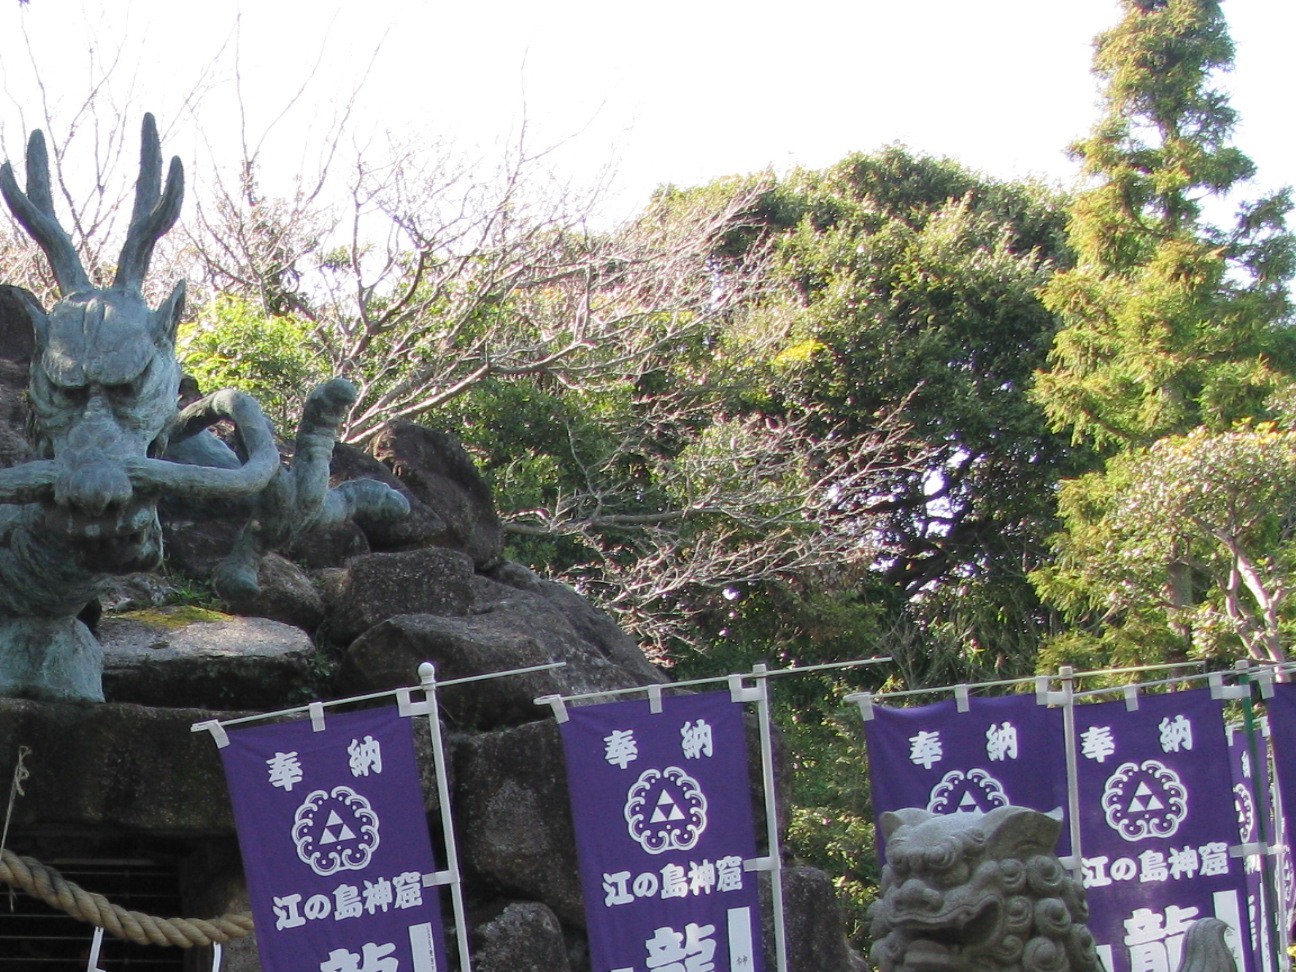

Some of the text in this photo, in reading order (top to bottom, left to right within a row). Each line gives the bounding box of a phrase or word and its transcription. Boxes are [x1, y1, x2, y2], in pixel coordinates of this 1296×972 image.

[266, 736, 382, 791] 奉納
[604, 720, 713, 769] 奉納
[909, 721, 1018, 769] 奉納
[1080, 715, 1193, 764] 奉納
